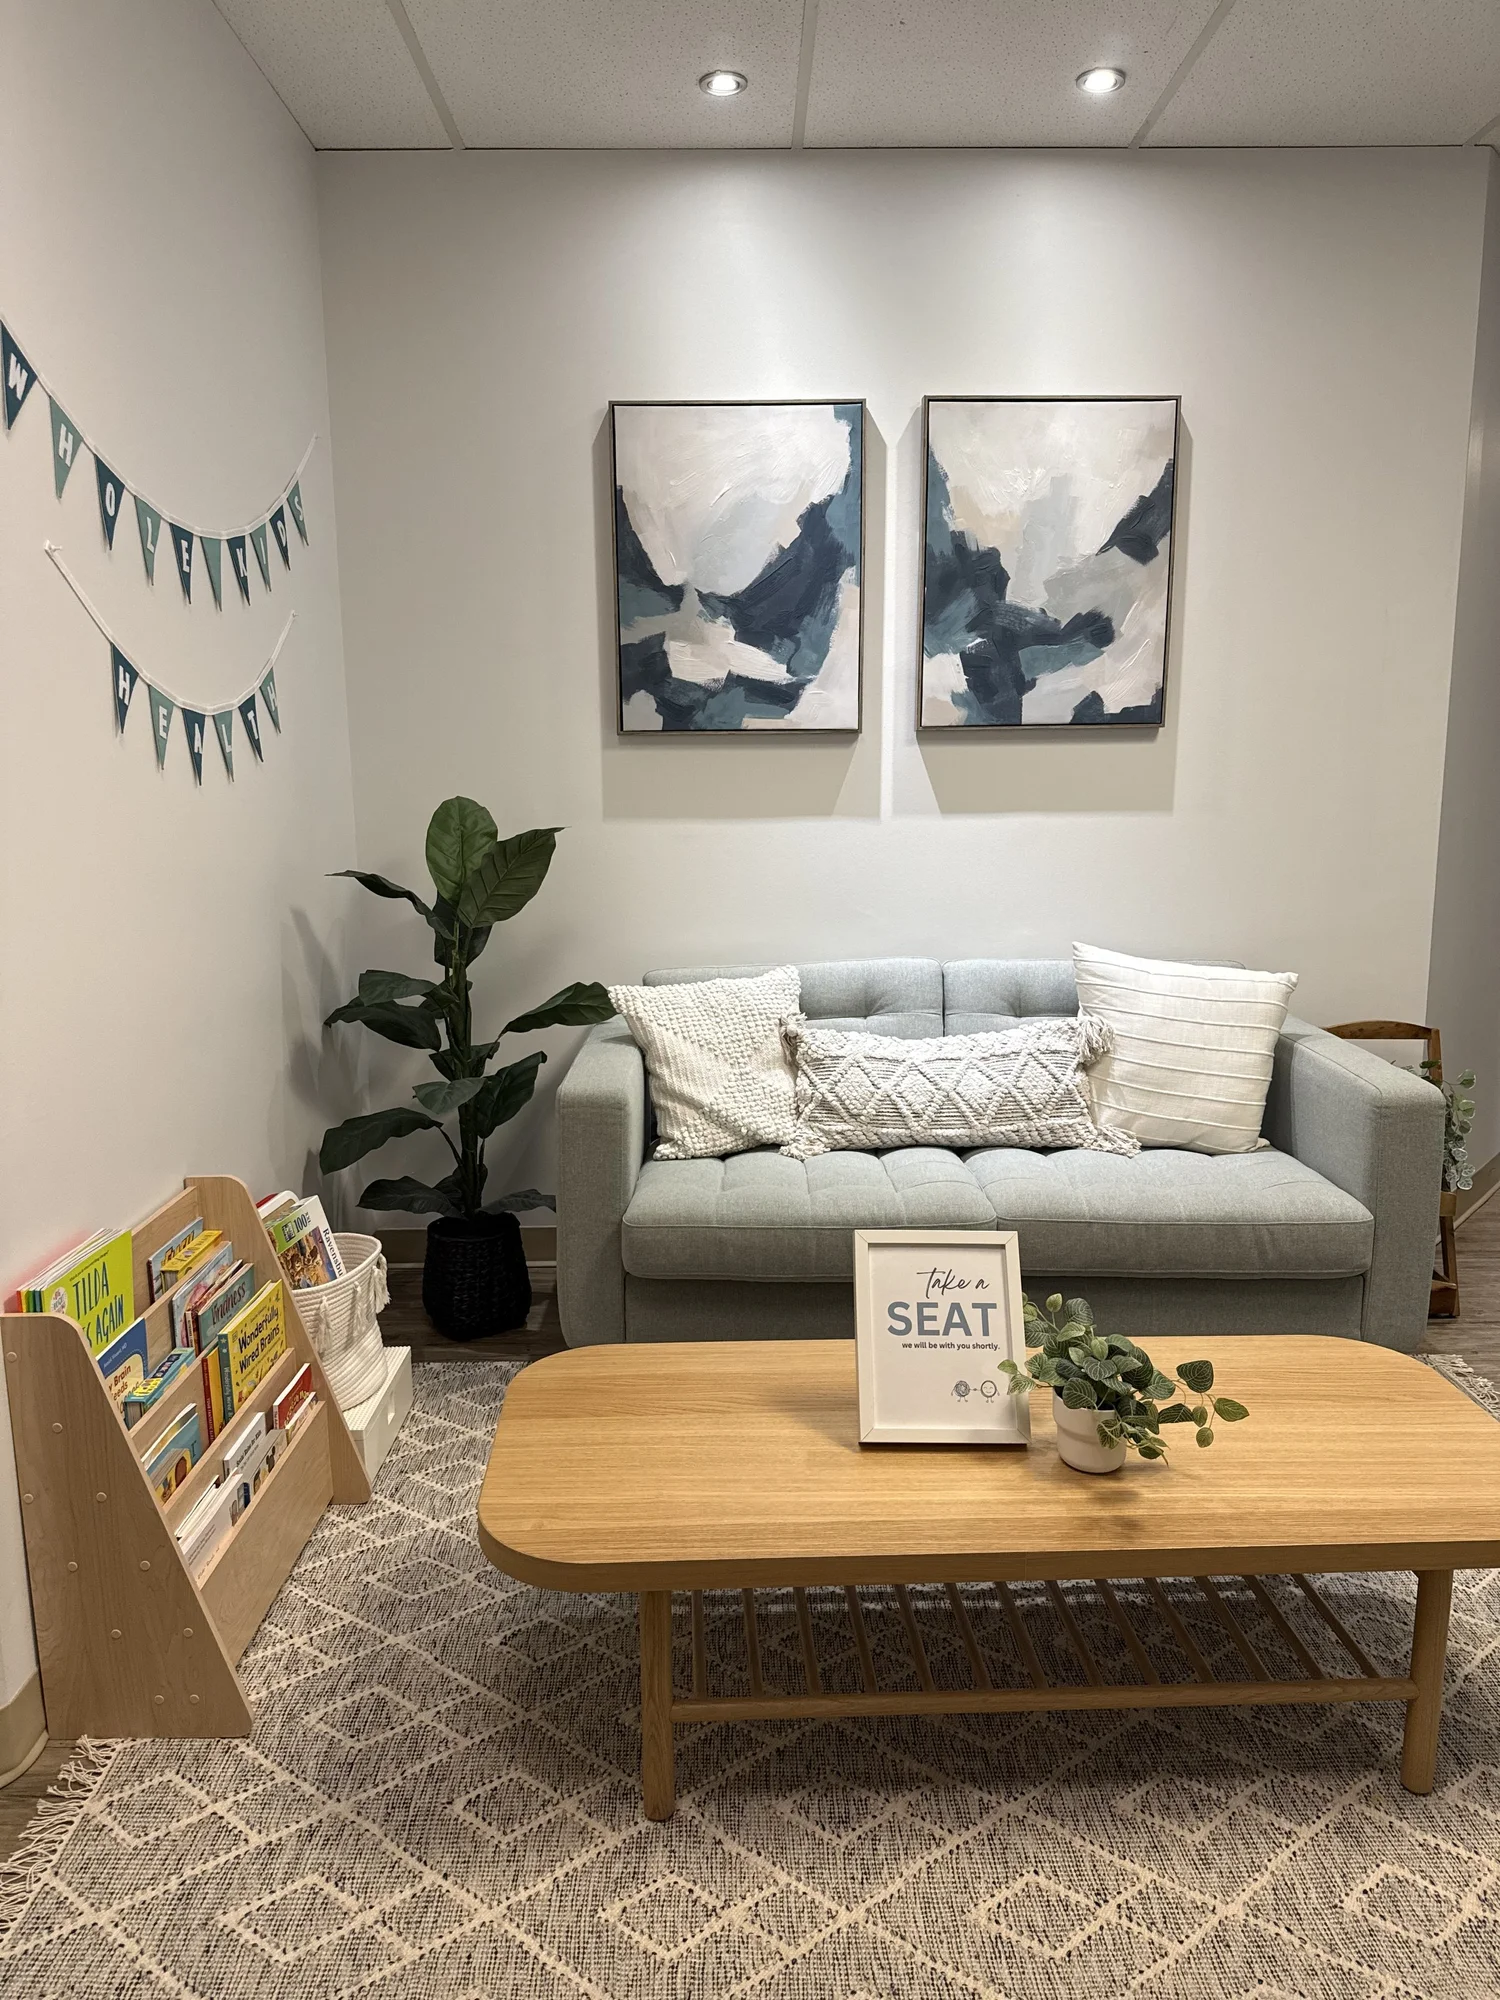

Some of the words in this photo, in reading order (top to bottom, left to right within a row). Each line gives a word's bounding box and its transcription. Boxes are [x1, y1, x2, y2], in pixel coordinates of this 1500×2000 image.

[8, 352, 190, 573] WHOLE
[236, 495, 304, 577] KIDS
[118, 665, 278, 754] HEALTH
[293, 1213, 307, 1233] 100
[72, 1261, 109, 1320] TILDA
[975, 1278, 989, 1290] a
[96, 1294, 124, 1345] AGAIN
[238, 1305, 279, 1354] Wonderfully
[887, 1301, 997, 1337] SEAT
[239, 1343, 260, 1374] Wired
[260, 1323, 280, 1352] Brains
[972, 1342, 1000, 1352] shortly.
[112, 1381, 128, 1400] eeds
[113, 1365, 131, 1386] Brain
